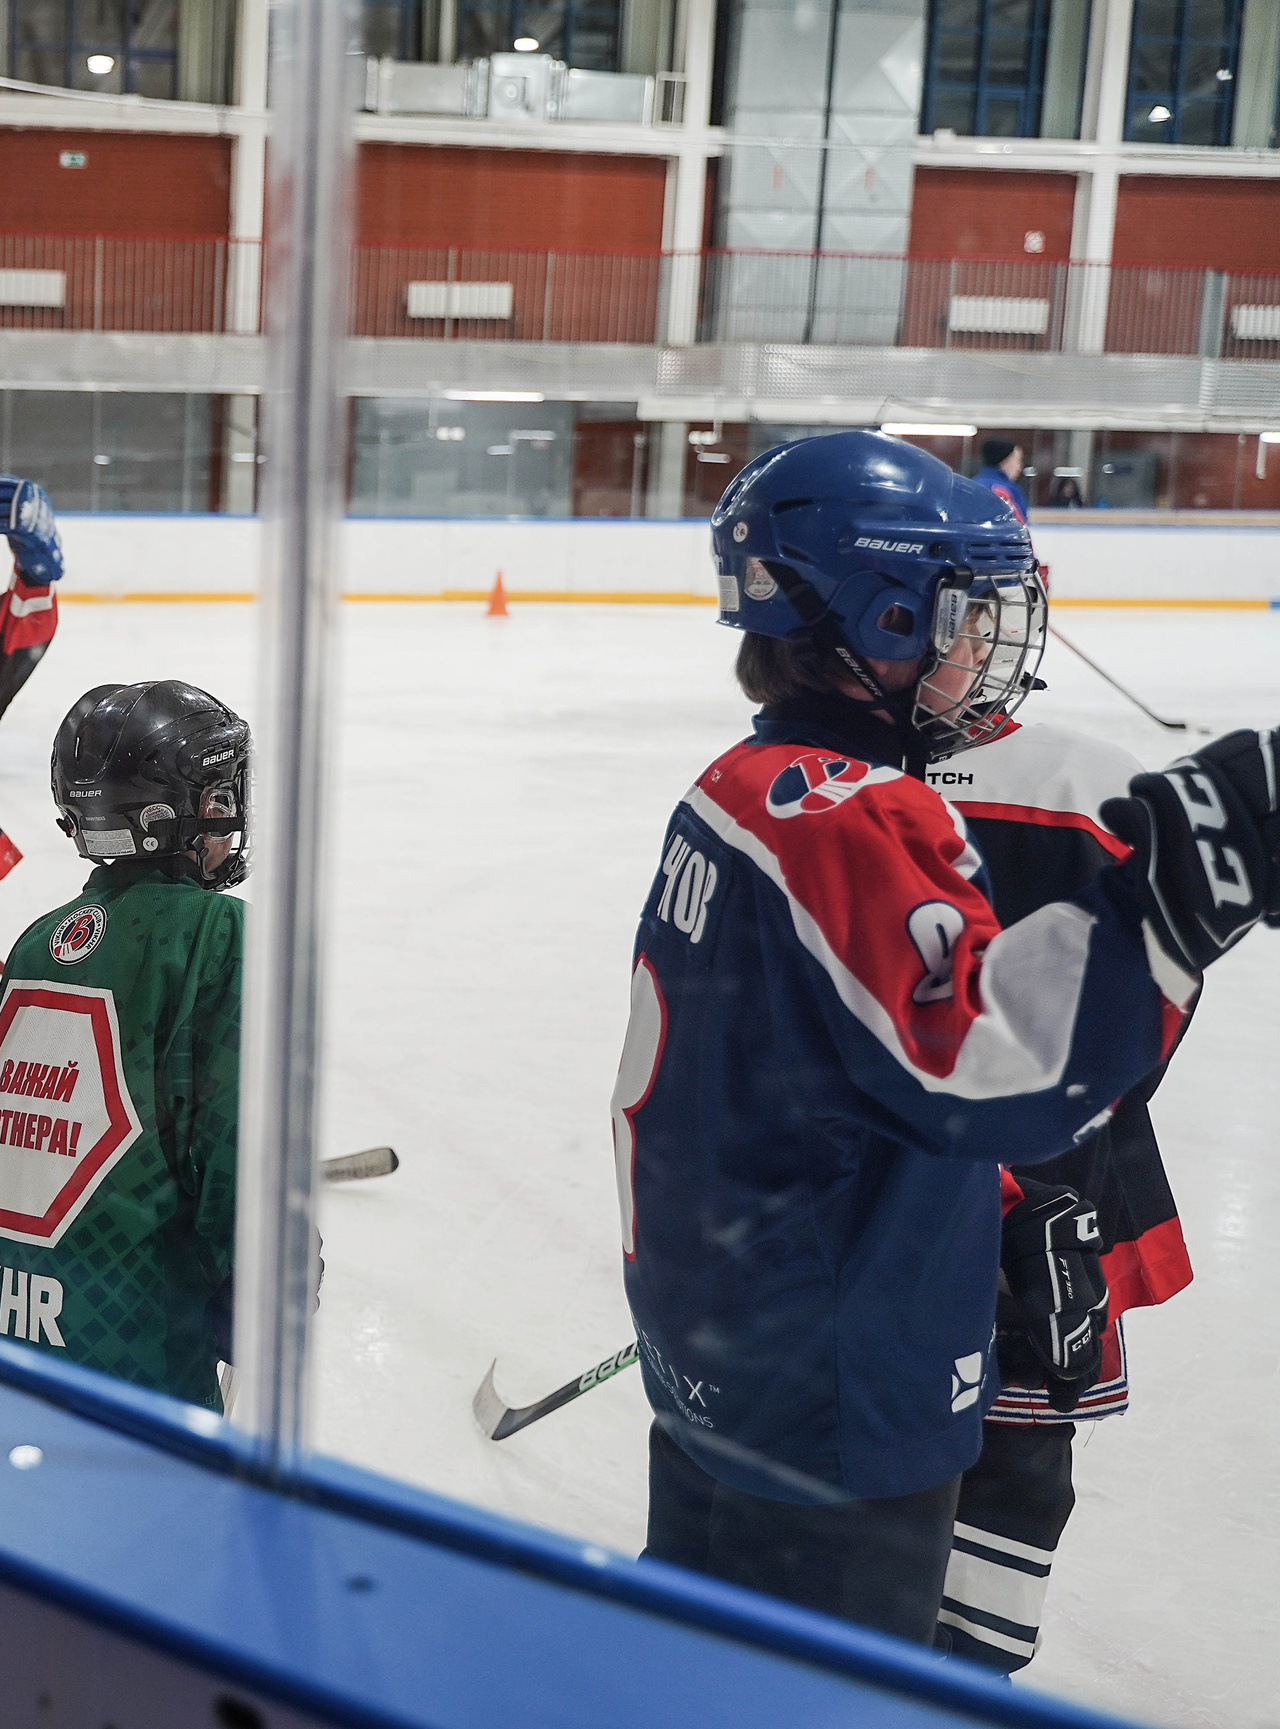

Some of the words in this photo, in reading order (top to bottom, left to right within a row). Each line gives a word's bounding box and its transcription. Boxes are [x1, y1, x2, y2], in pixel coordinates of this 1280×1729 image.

[927, 772, 974, 785] TCH
[1163, 756, 1254, 909] CC
[579, 1340, 639, 1392] BAU
